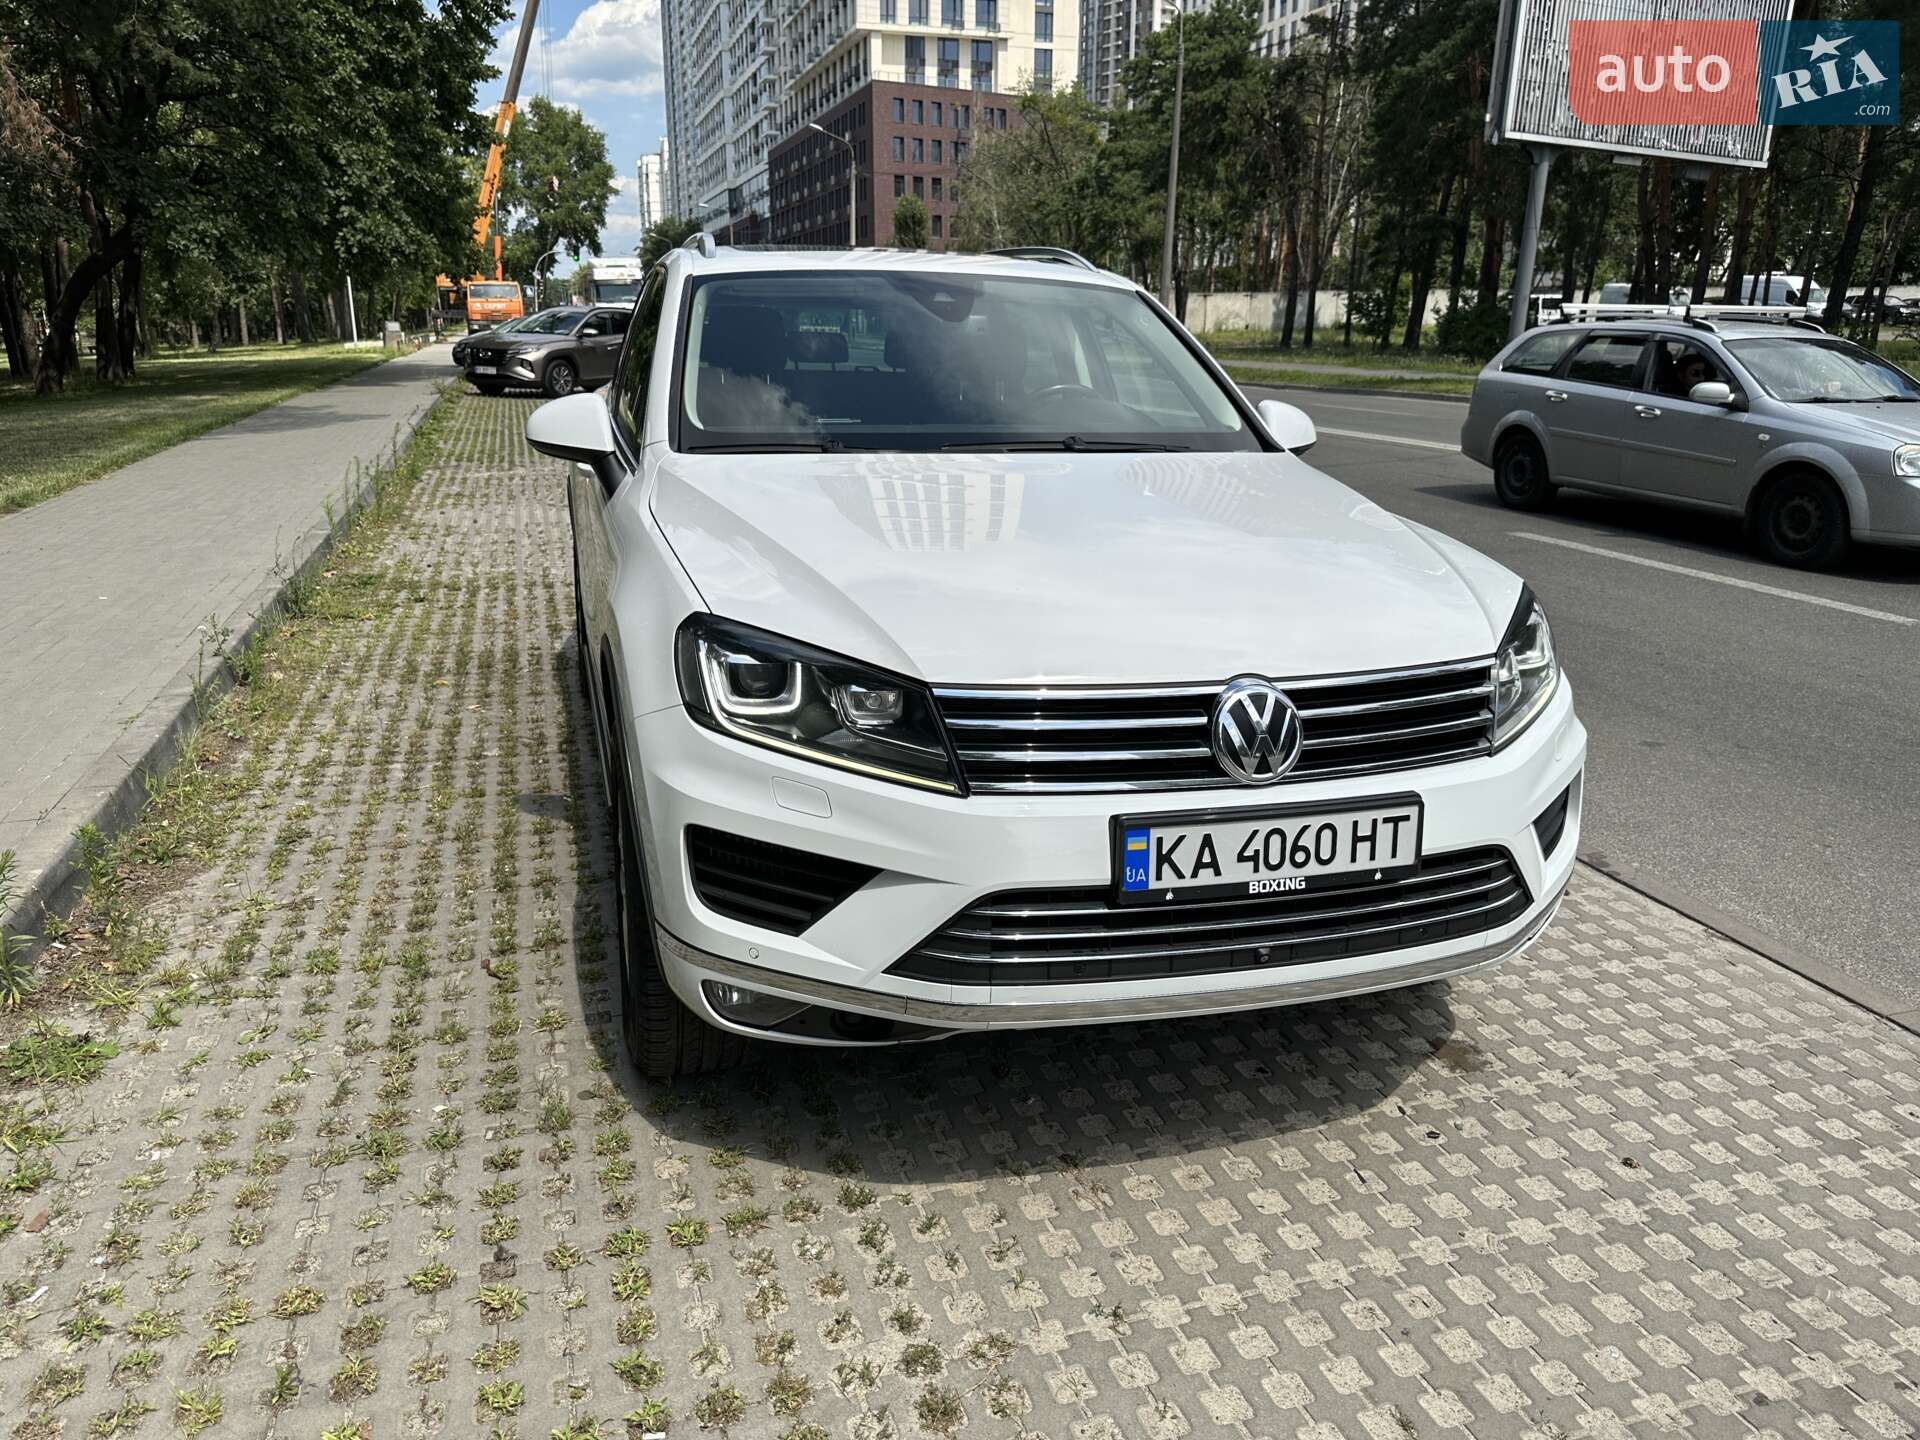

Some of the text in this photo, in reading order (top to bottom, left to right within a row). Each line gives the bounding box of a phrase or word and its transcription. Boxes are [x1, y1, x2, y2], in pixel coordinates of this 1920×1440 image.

[1155, 815, 1411, 882] KA 4060 HT
[1126, 866, 1147, 883] UA
[1249, 877, 1307, 895] BOXING
